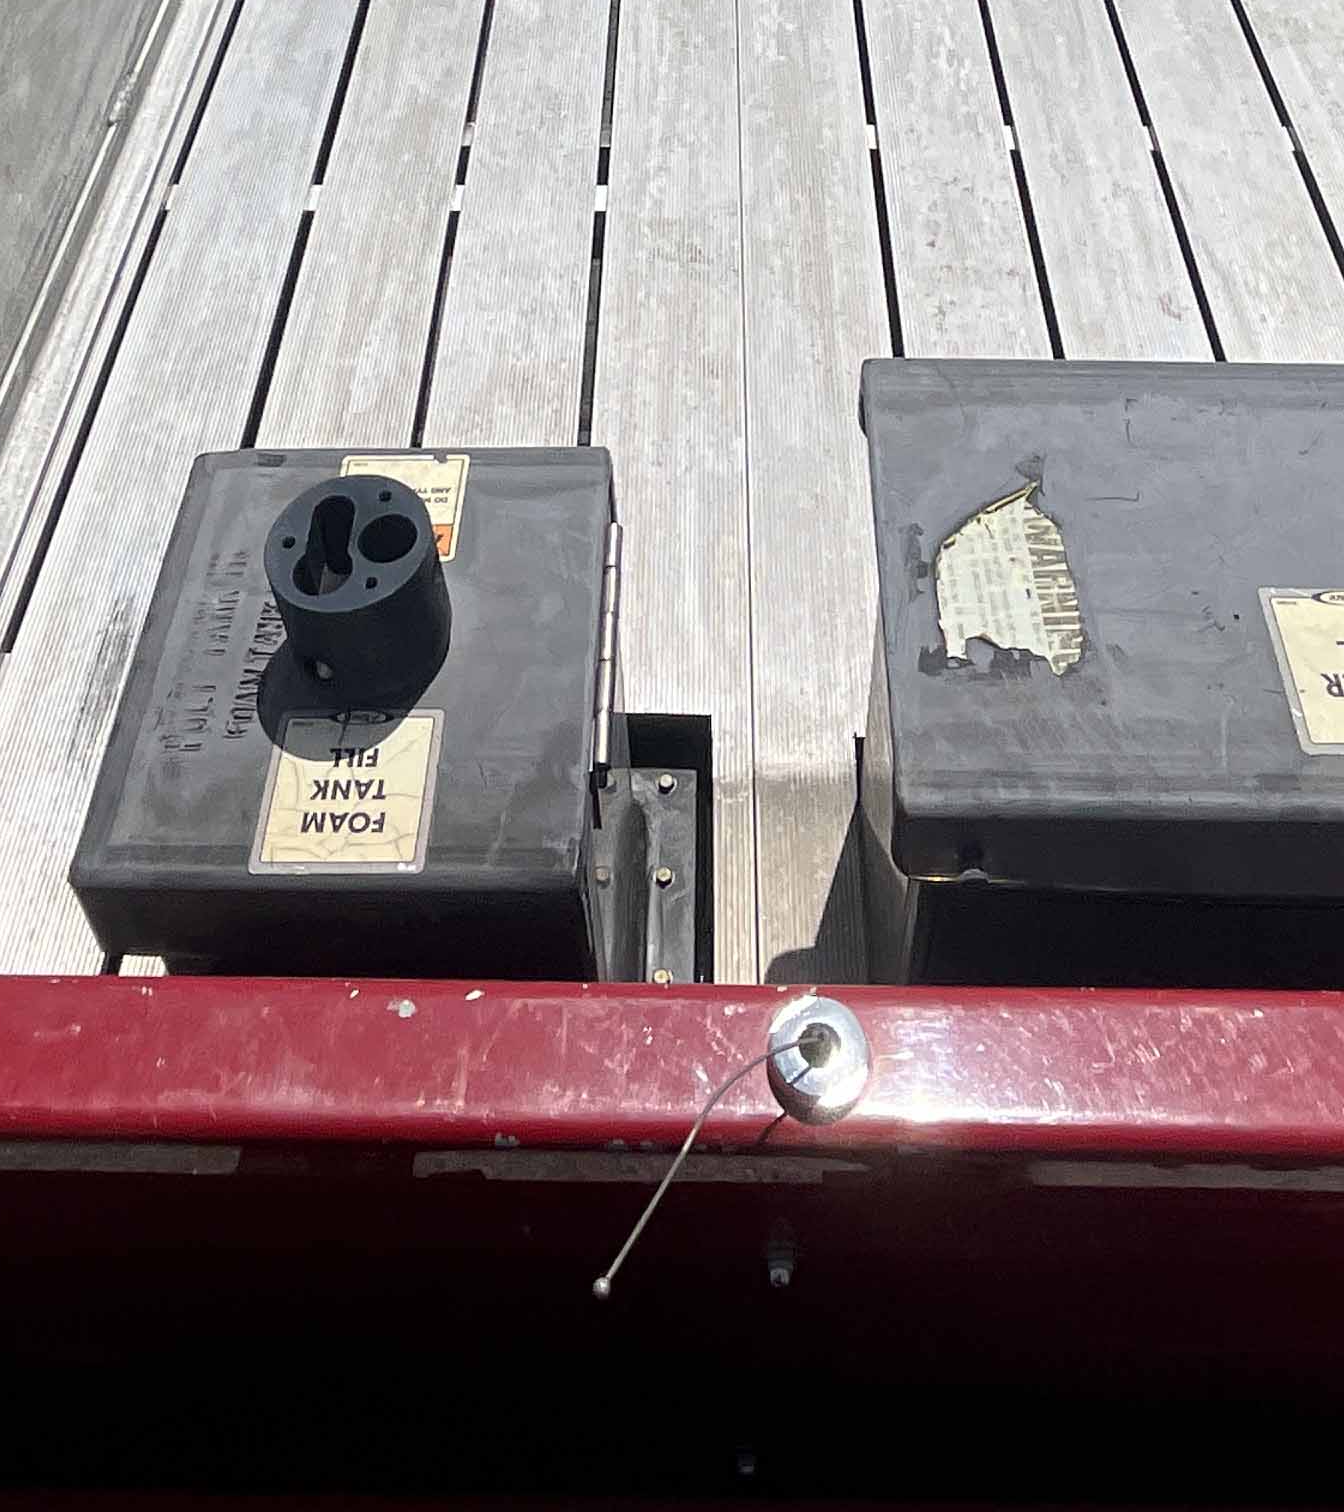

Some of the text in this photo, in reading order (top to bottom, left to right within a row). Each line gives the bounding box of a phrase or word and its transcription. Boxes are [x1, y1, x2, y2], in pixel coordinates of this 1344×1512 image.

[329, 747, 380, 768] FILL
[310, 779, 386, 801] TANK
[300, 811, 386, 834] FOAM
